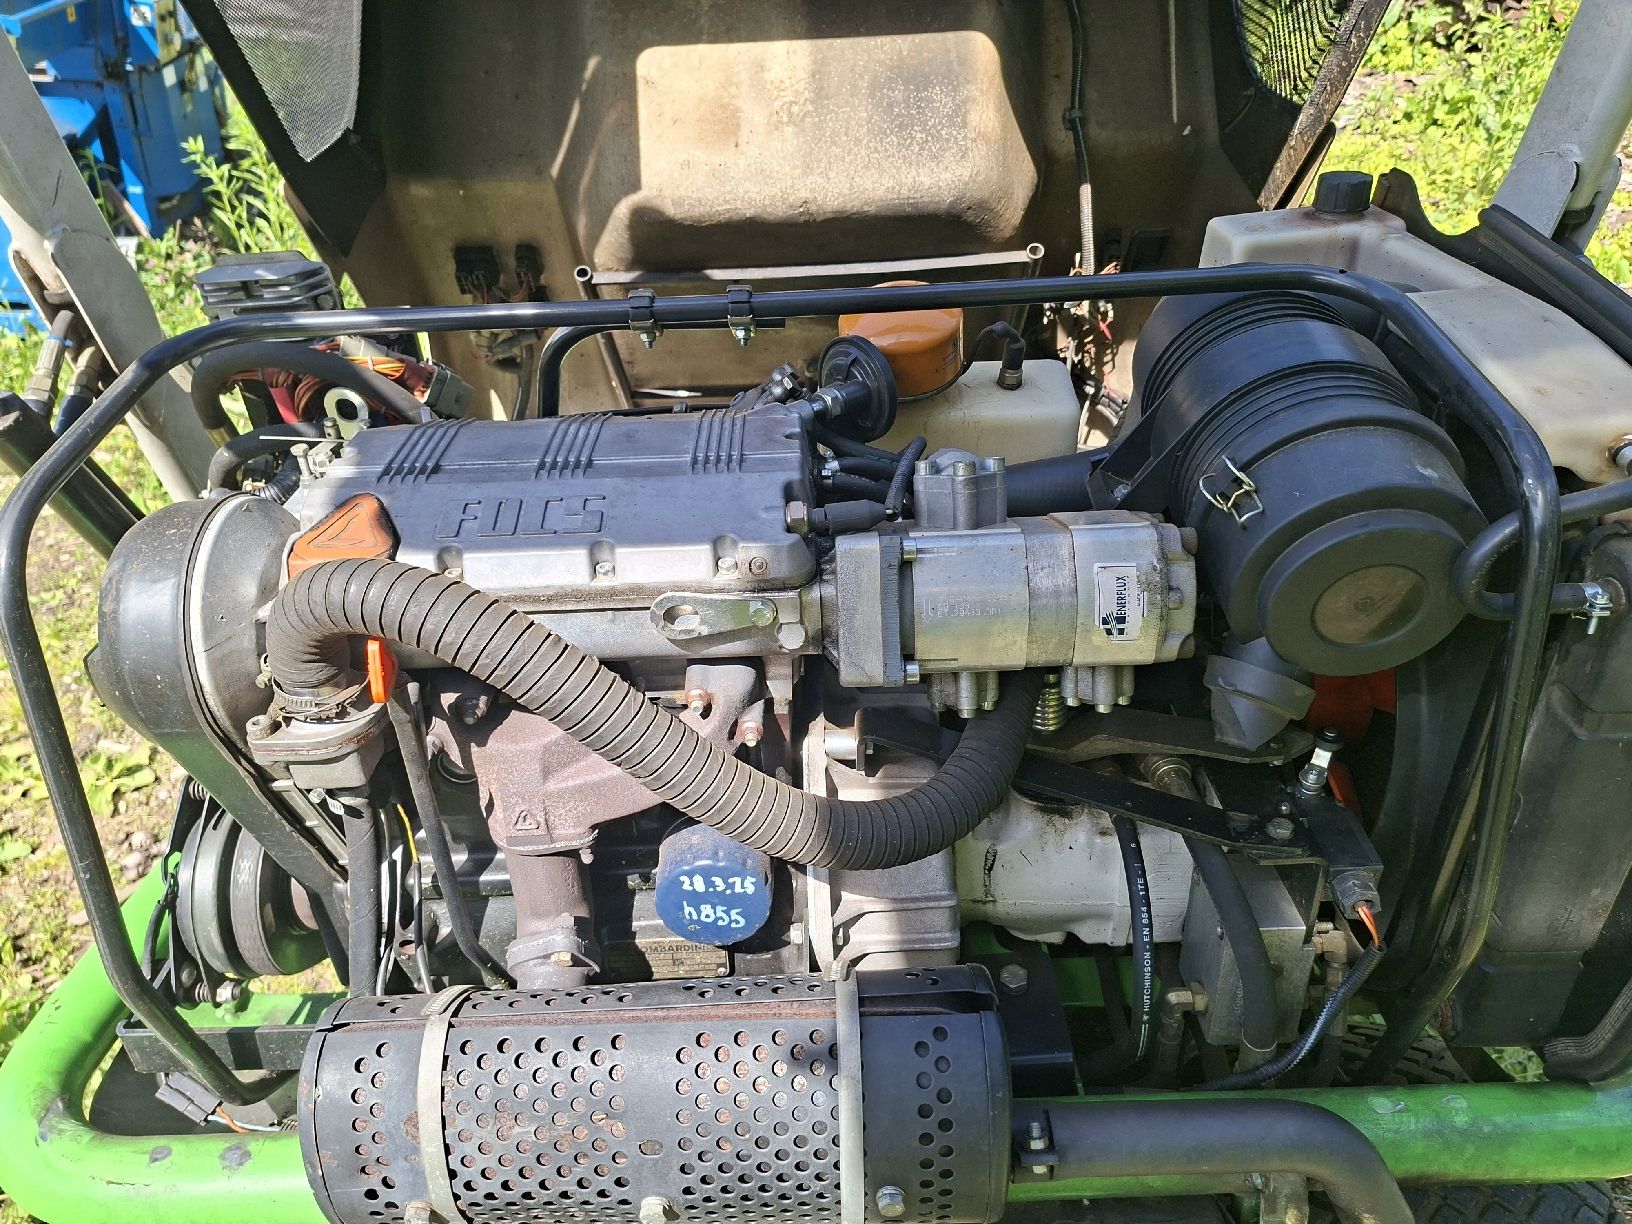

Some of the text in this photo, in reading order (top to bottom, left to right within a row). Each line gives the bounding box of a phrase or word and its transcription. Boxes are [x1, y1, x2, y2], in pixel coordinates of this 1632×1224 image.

[434, 495, 607, 538] FOCS
[1115, 576, 1127, 616] ENERFLUX
[1137, 877, 1146, 896] 1TE
[1141, 906, 1149, 924] 854
[1143, 927, 1150, 942] EN
[1143, 952, 1152, 1011] HUTCHINSON
